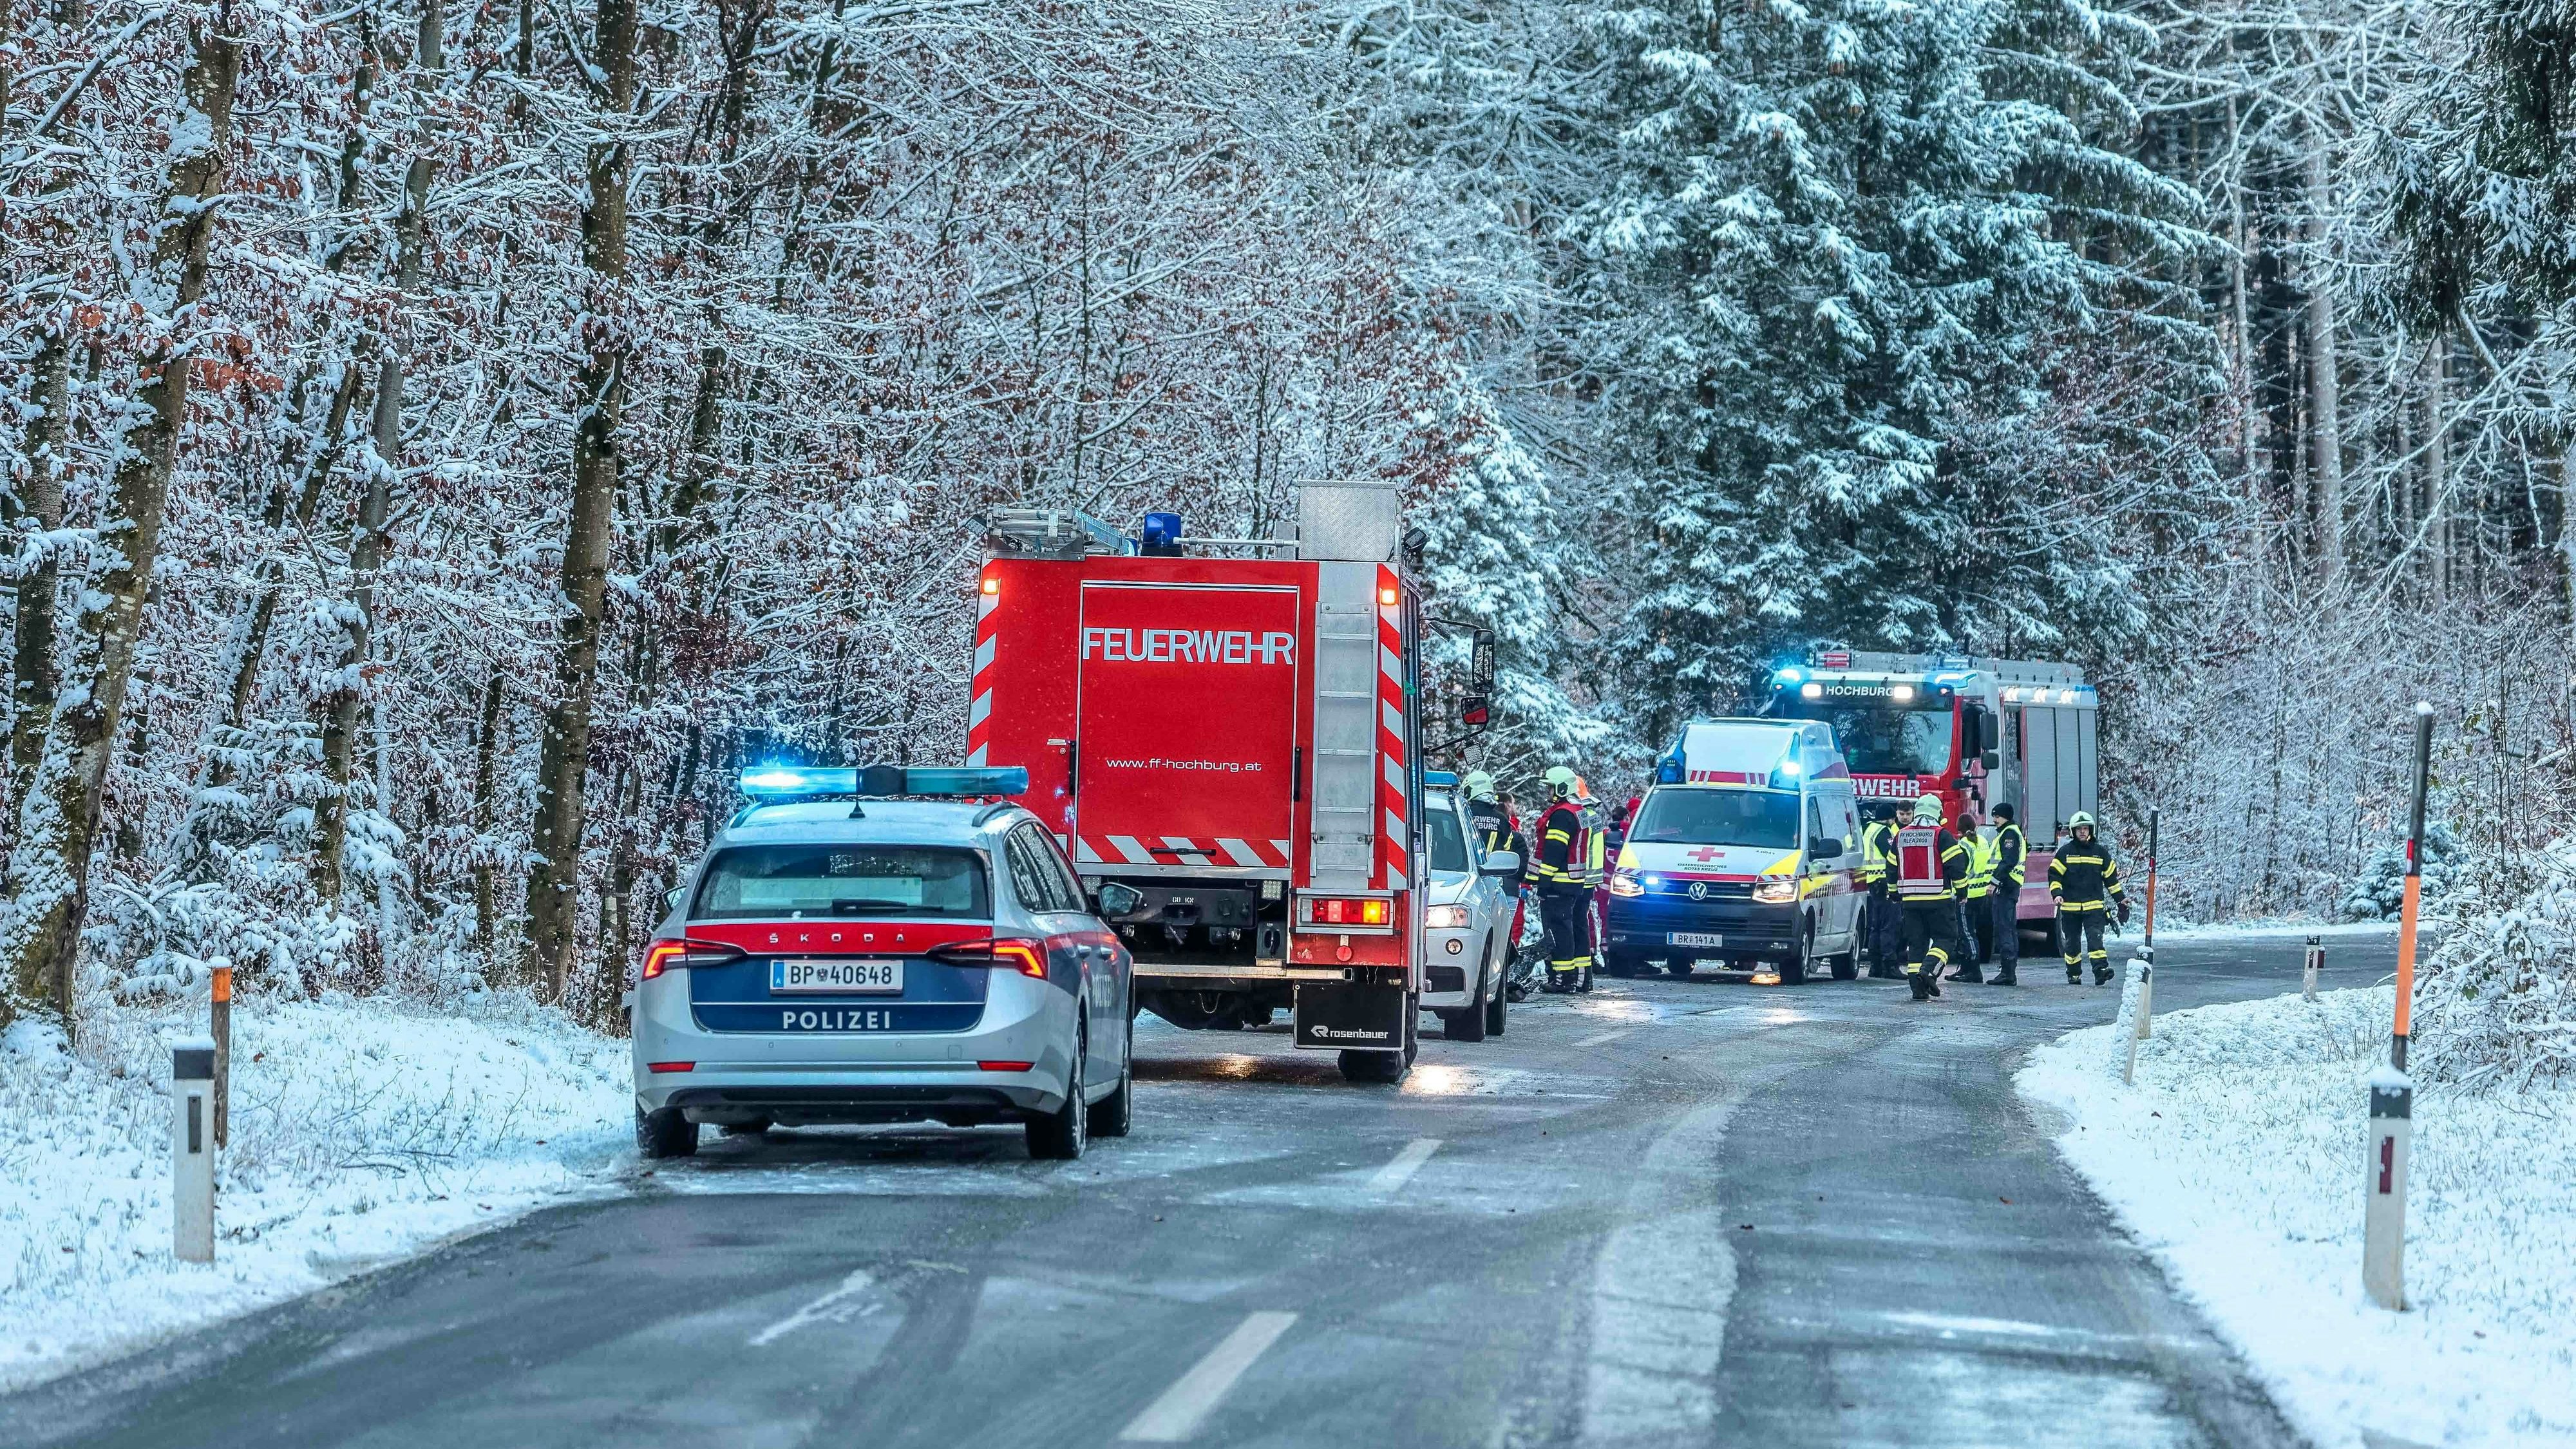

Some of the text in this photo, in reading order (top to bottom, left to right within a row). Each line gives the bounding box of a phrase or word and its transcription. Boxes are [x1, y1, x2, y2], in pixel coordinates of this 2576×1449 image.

[1083, 627, 1294, 665] FEUERWEHR
[1106, 759, 1262, 772] www.ff-hochburg.at
[1678, 935, 1689, 943] BR
[790, 965, 892, 985] BP 40648
[783, 1011, 890, 1029] POLIZEI
[1330, 1028, 1388, 1039] rosenbauer
